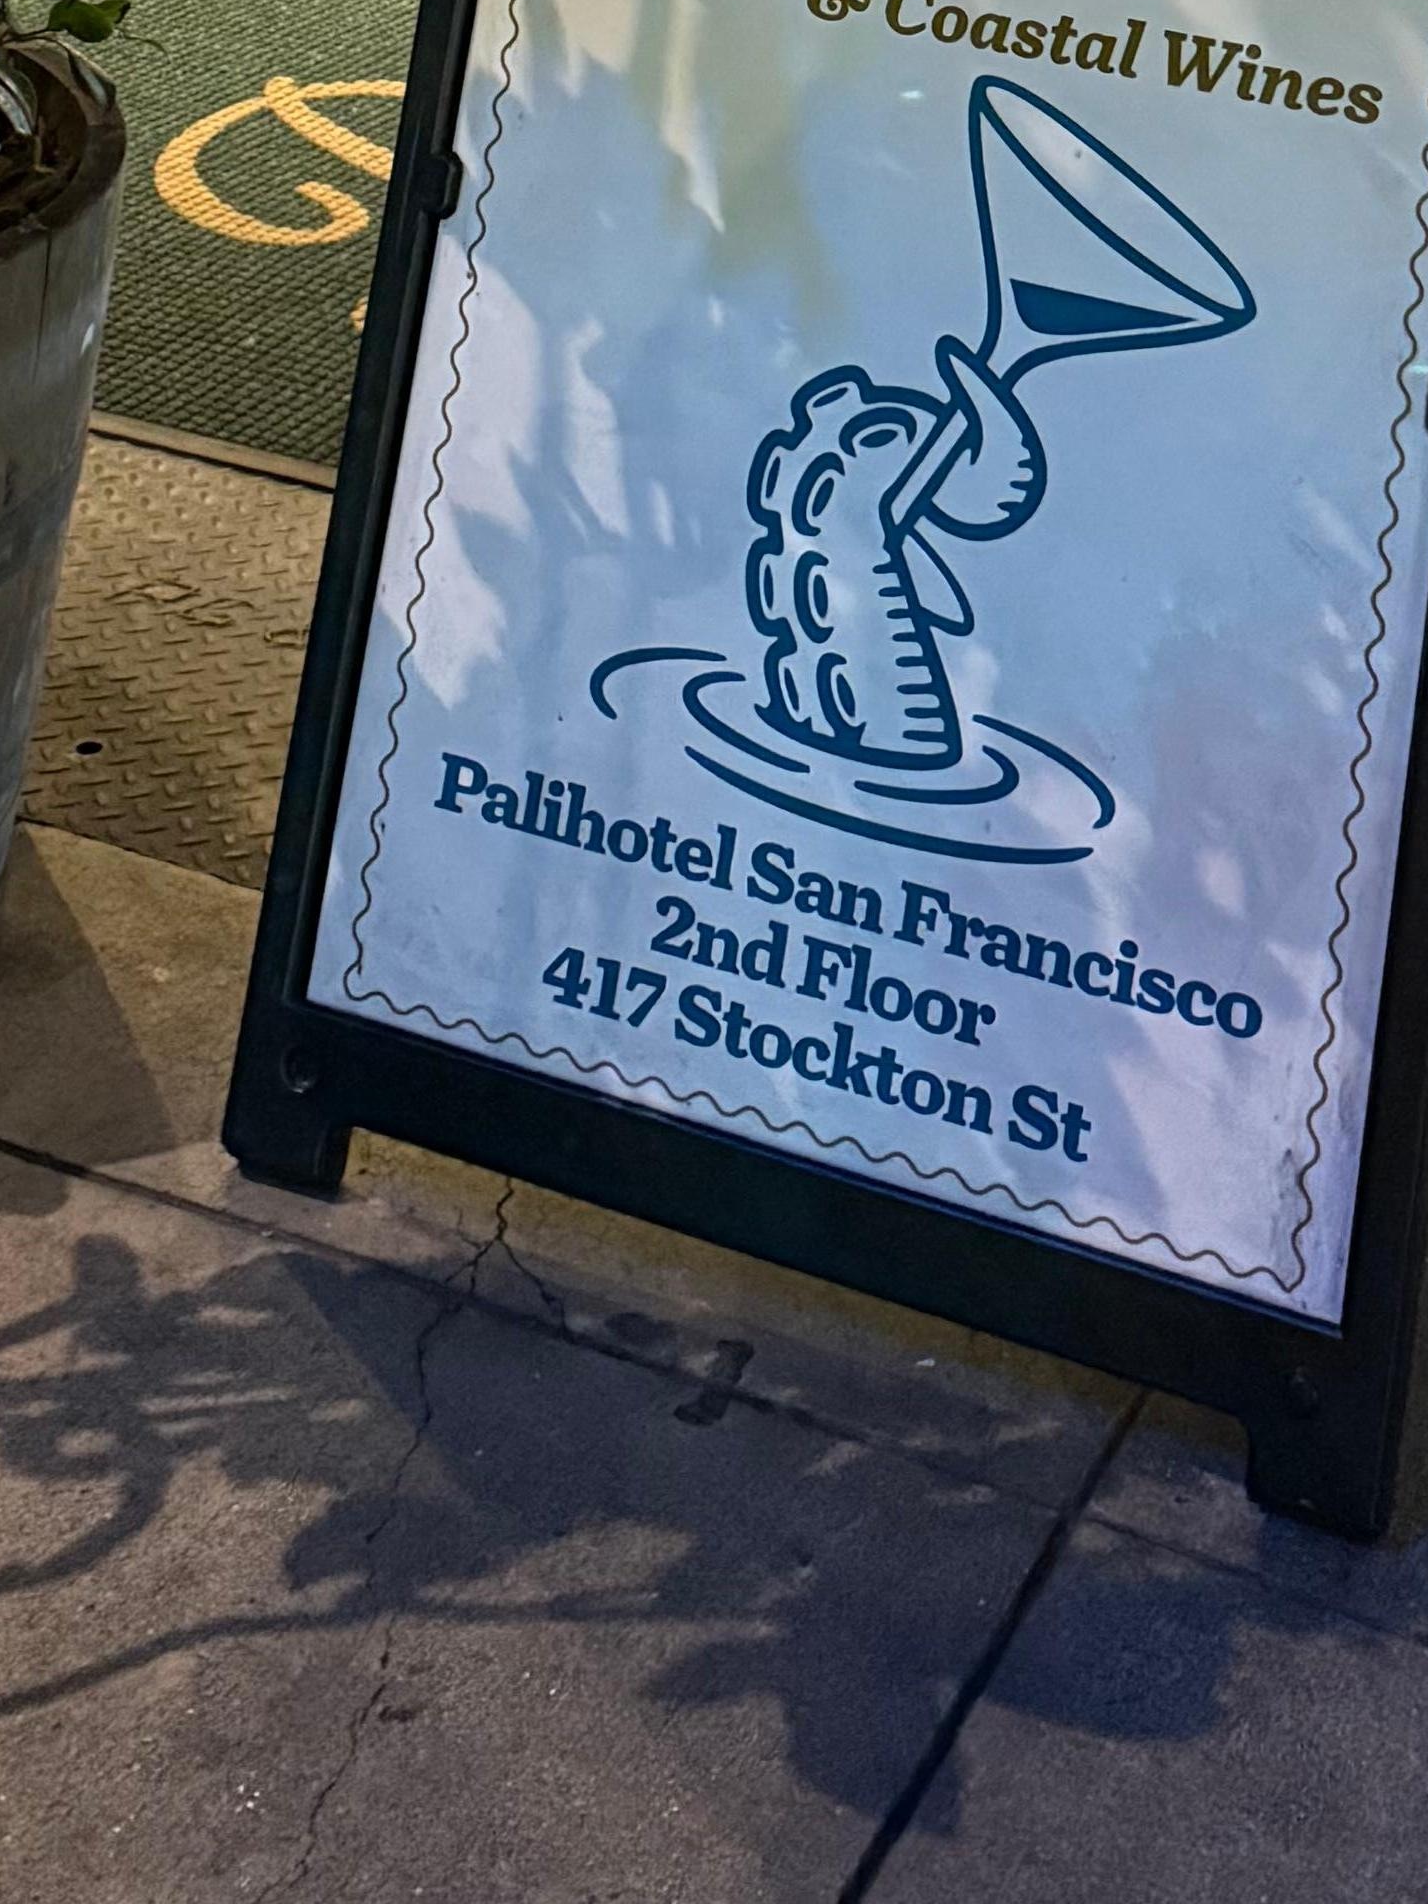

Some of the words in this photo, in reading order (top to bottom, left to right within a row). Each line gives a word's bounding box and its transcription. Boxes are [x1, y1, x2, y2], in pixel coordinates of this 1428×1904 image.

[1166, 29, 1386, 128] Wines
[432, 750, 740, 894] Palihotel
[744, 842, 884, 935] San
[894, 878, 1264, 1041] Francisco
[649, 895, 788, 990] 2nd
[799, 949, 996, 1050] Floor
[541, 943, 667, 1030] 417
[673, 982, 995, 1138] Stockton
[1006, 1081, 1094, 1165] St
